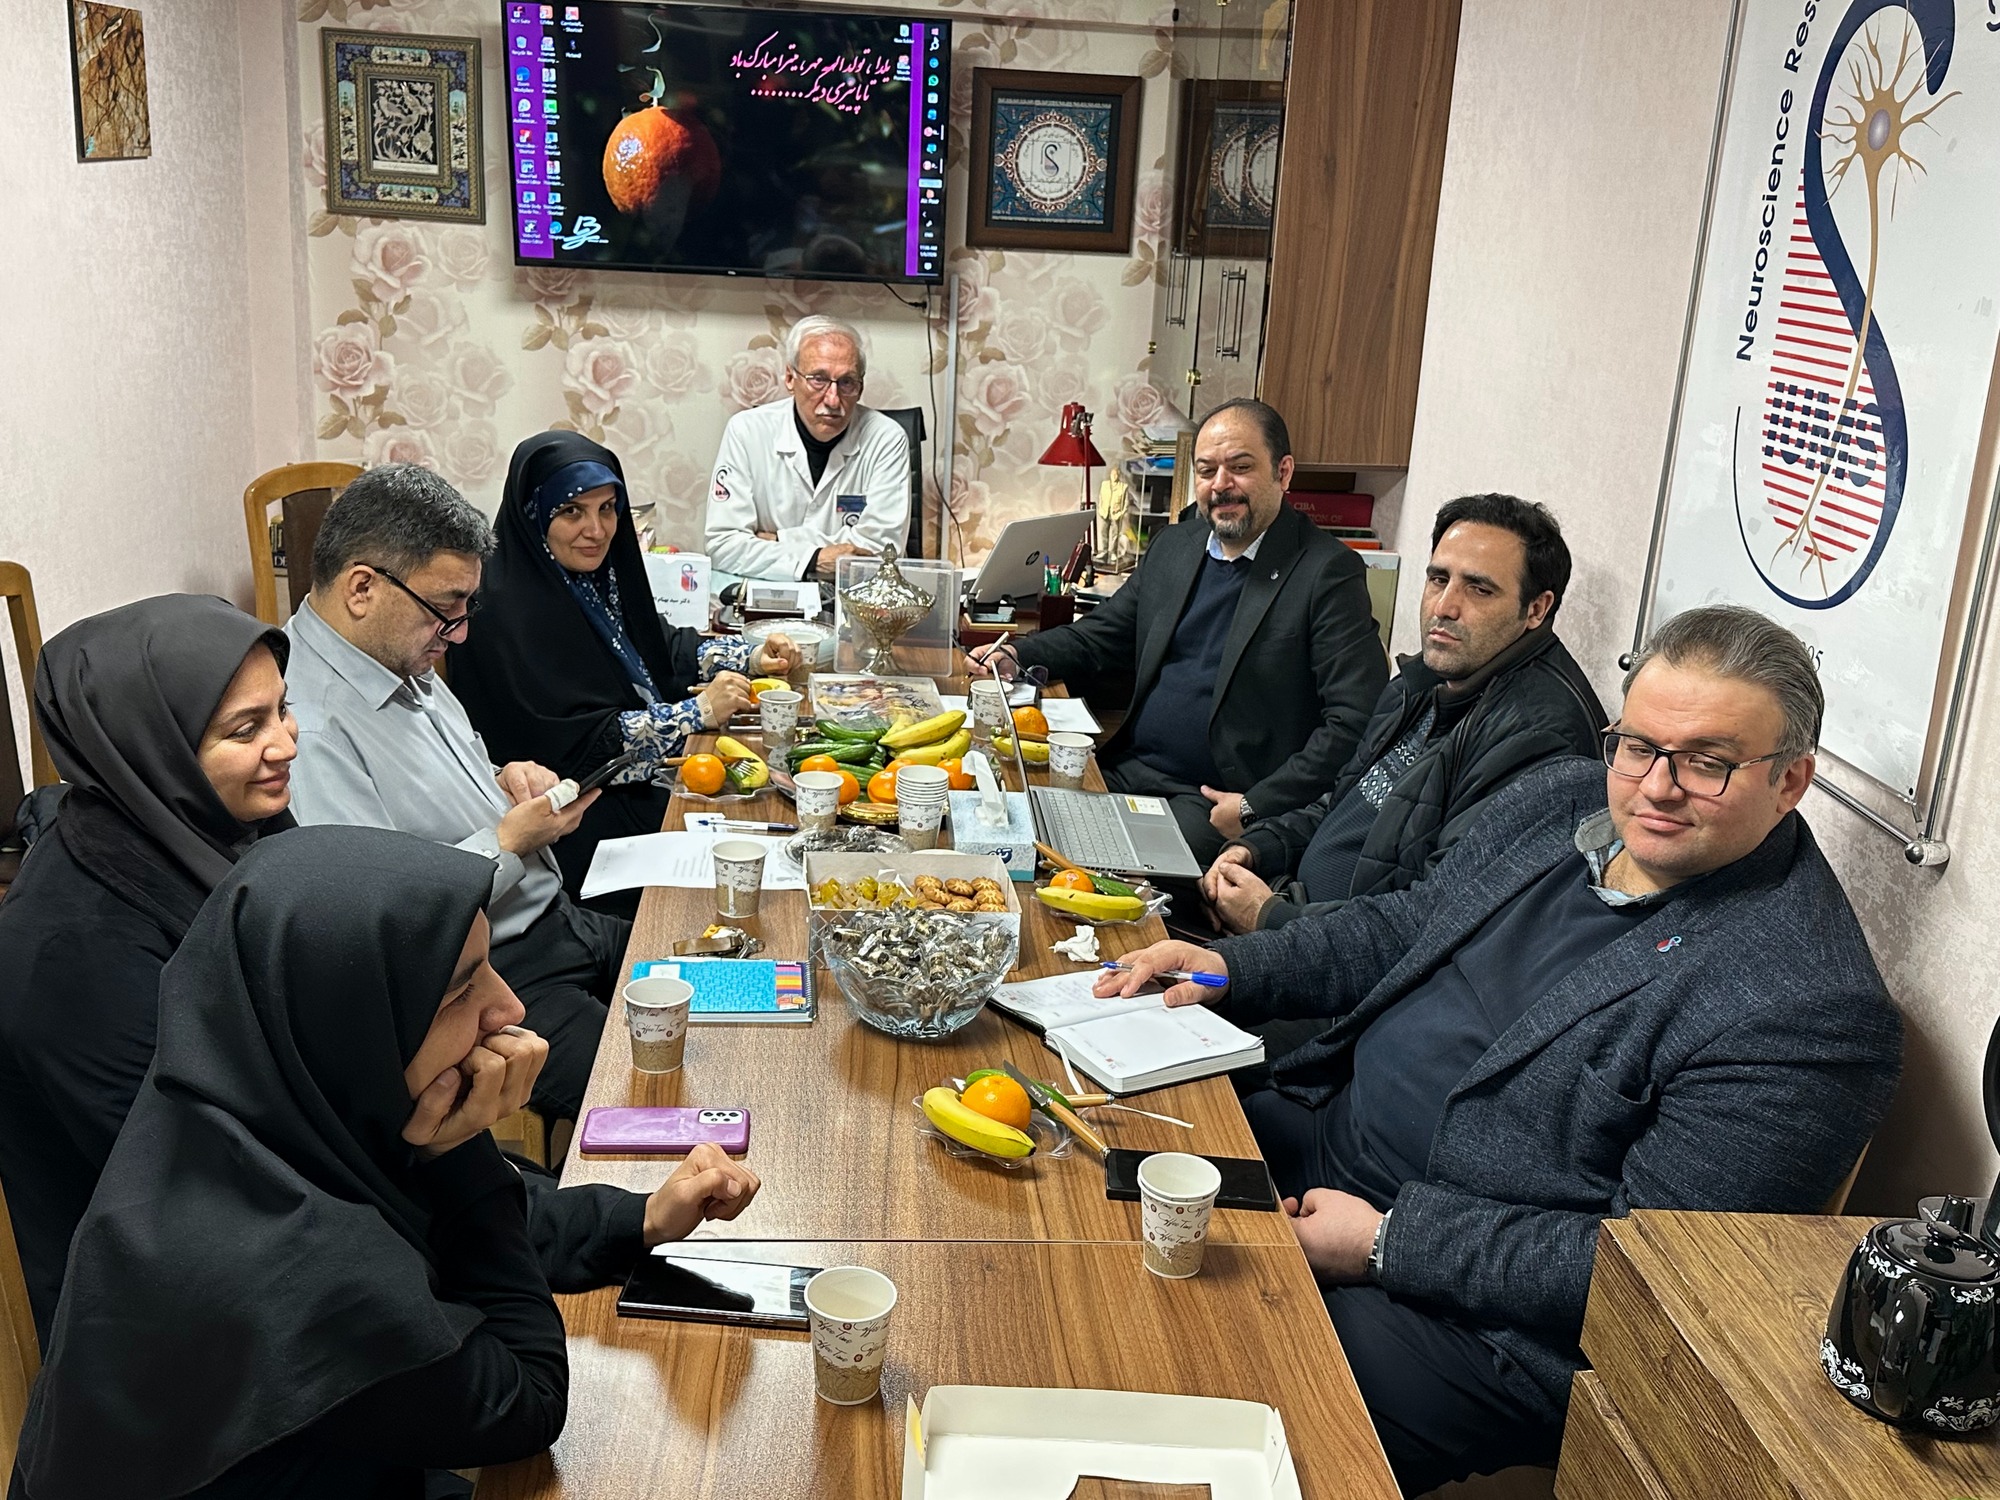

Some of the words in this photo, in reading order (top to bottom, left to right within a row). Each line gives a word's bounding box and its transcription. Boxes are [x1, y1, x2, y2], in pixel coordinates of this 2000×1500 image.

[729, 50, 744, 79] باد
[743, 30, 779, 80] مبارک
[775, 43, 800, 75] میترا
[842, 48, 871, 74] تولد
[863, 79, 877, 101] تا
[1736, 88, 1793, 361] Neuroscience
[1784, 0, 1820, 73] Res
[1293, 502, 1315, 511] CIBA
[636, 1022, 654, 1034] Coffee
[654, 1024, 667, 1033] Time
[1158, 1212, 1179, 1227] Coffee
[1180, 1219, 1193, 1229] Time
[1155, 1226, 1176, 1241] Coffee
[1176, 1235, 1189, 1245] Time
[814, 1330, 833, 1353] Coffee
[833, 1347, 849, 1362] Time
[836, 1327, 853, 1344] Time
